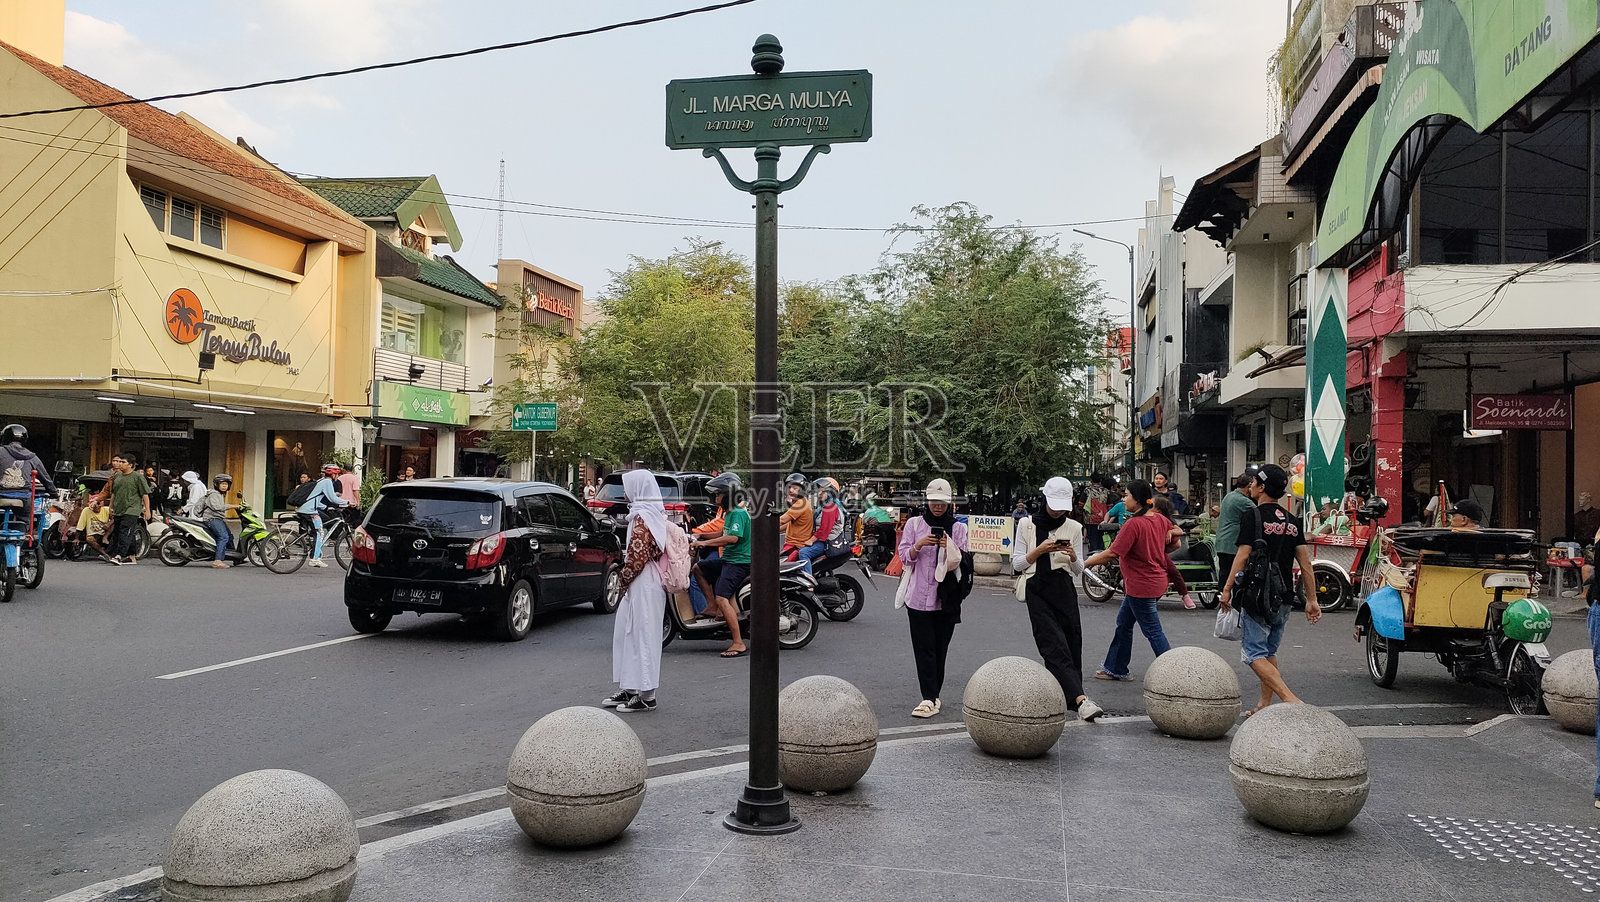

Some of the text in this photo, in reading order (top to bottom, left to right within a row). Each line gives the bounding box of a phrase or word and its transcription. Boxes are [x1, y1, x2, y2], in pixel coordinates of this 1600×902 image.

[1504, 15, 1552, 77] DATANG
[1415, 49, 1440, 65] WISATA
[1384, 58, 1410, 126] KAWASAN
[683, 90, 853, 114] JL. MARGA MULYA
[1328, 206, 1350, 237] SELAMAT
[1476, 397, 1568, 420] Soenardi
[1497, 399, 1525, 407] Batik
[974, 517, 1005, 526] PARKIR
[971, 530, 1001, 540] MOBIL
[970, 542, 1002, 552] MOTOR
[1523, 617, 1552, 630] Grab
